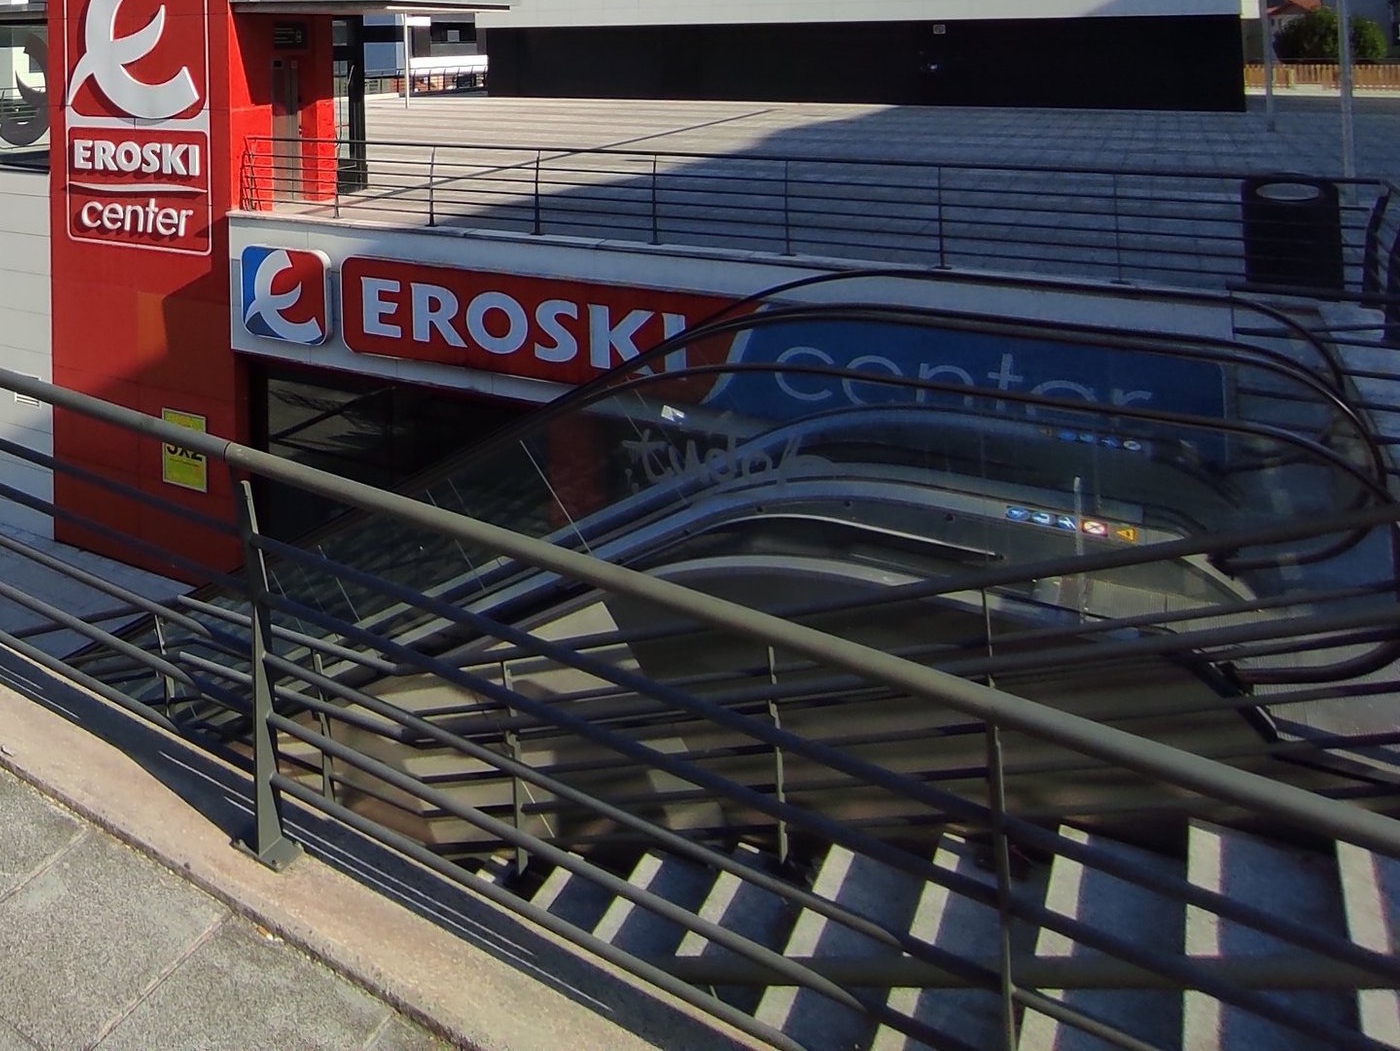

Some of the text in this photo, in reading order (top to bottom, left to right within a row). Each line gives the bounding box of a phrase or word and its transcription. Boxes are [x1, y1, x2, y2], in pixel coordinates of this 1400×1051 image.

[73, 139, 200, 176] EROSKI
[81, 198, 193, 237] center
[360, 276, 688, 381] EROSKI
